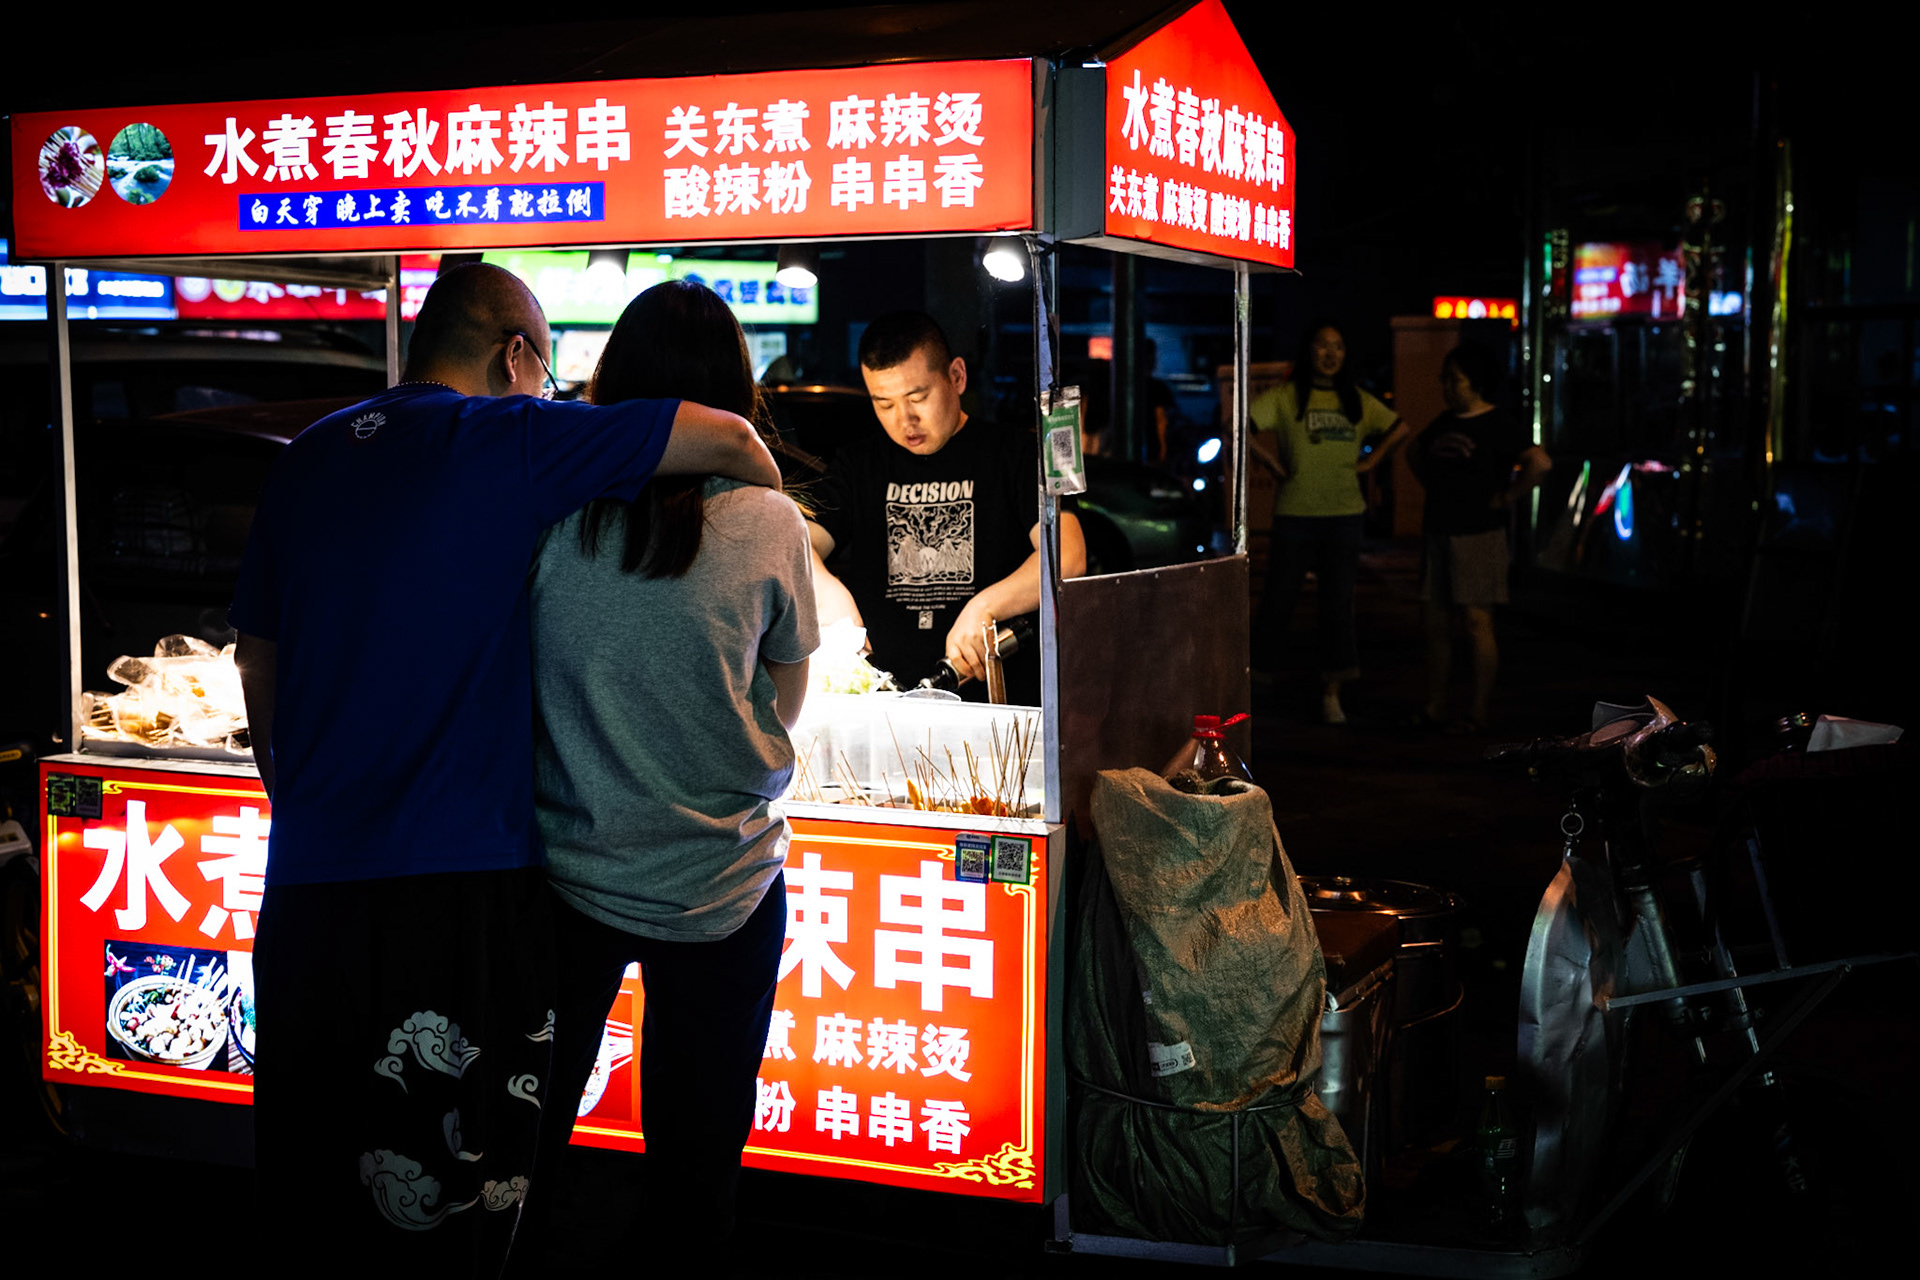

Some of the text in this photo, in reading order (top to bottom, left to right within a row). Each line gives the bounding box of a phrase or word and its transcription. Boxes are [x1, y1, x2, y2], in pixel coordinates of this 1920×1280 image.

[204, 98, 631, 185] 水煮春秋麻辣串
[663, 92, 985, 158] 关东煮 麻辣烫
[1121, 69, 1285, 192] 水煮春秋麻辣串
[251, 186, 592, 226] 白天穿 晚上卖 吃不着就拉倒
[663, 153, 985, 219] 酸辣粉 串串香
[1109, 165, 1291, 250] 关东煮 麻辣烫 酸辣粉 串串香
[886, 480, 974, 503] DECISION
[812, 1012, 973, 1082] 麻辣烫
[815, 1086, 971, 1155] 串串香
